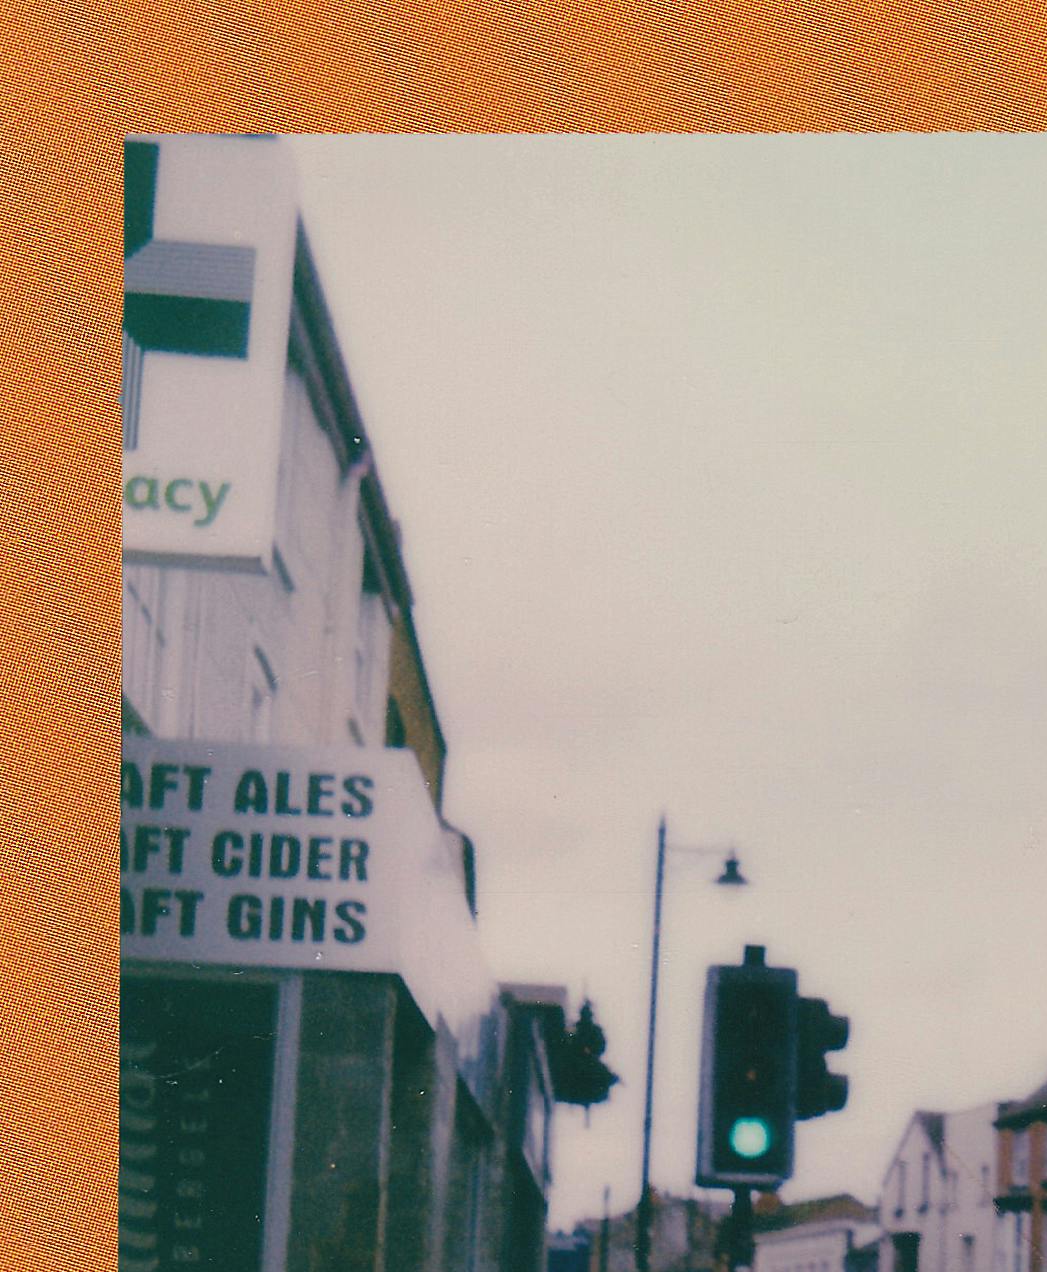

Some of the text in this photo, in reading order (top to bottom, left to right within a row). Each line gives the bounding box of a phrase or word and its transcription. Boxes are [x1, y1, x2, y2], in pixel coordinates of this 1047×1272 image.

[124, 474, 230, 527] acy
[234, 769, 374, 818] ALES
[119, 824, 370, 882] FT CIDER
[226, 892, 367, 944] GINS
